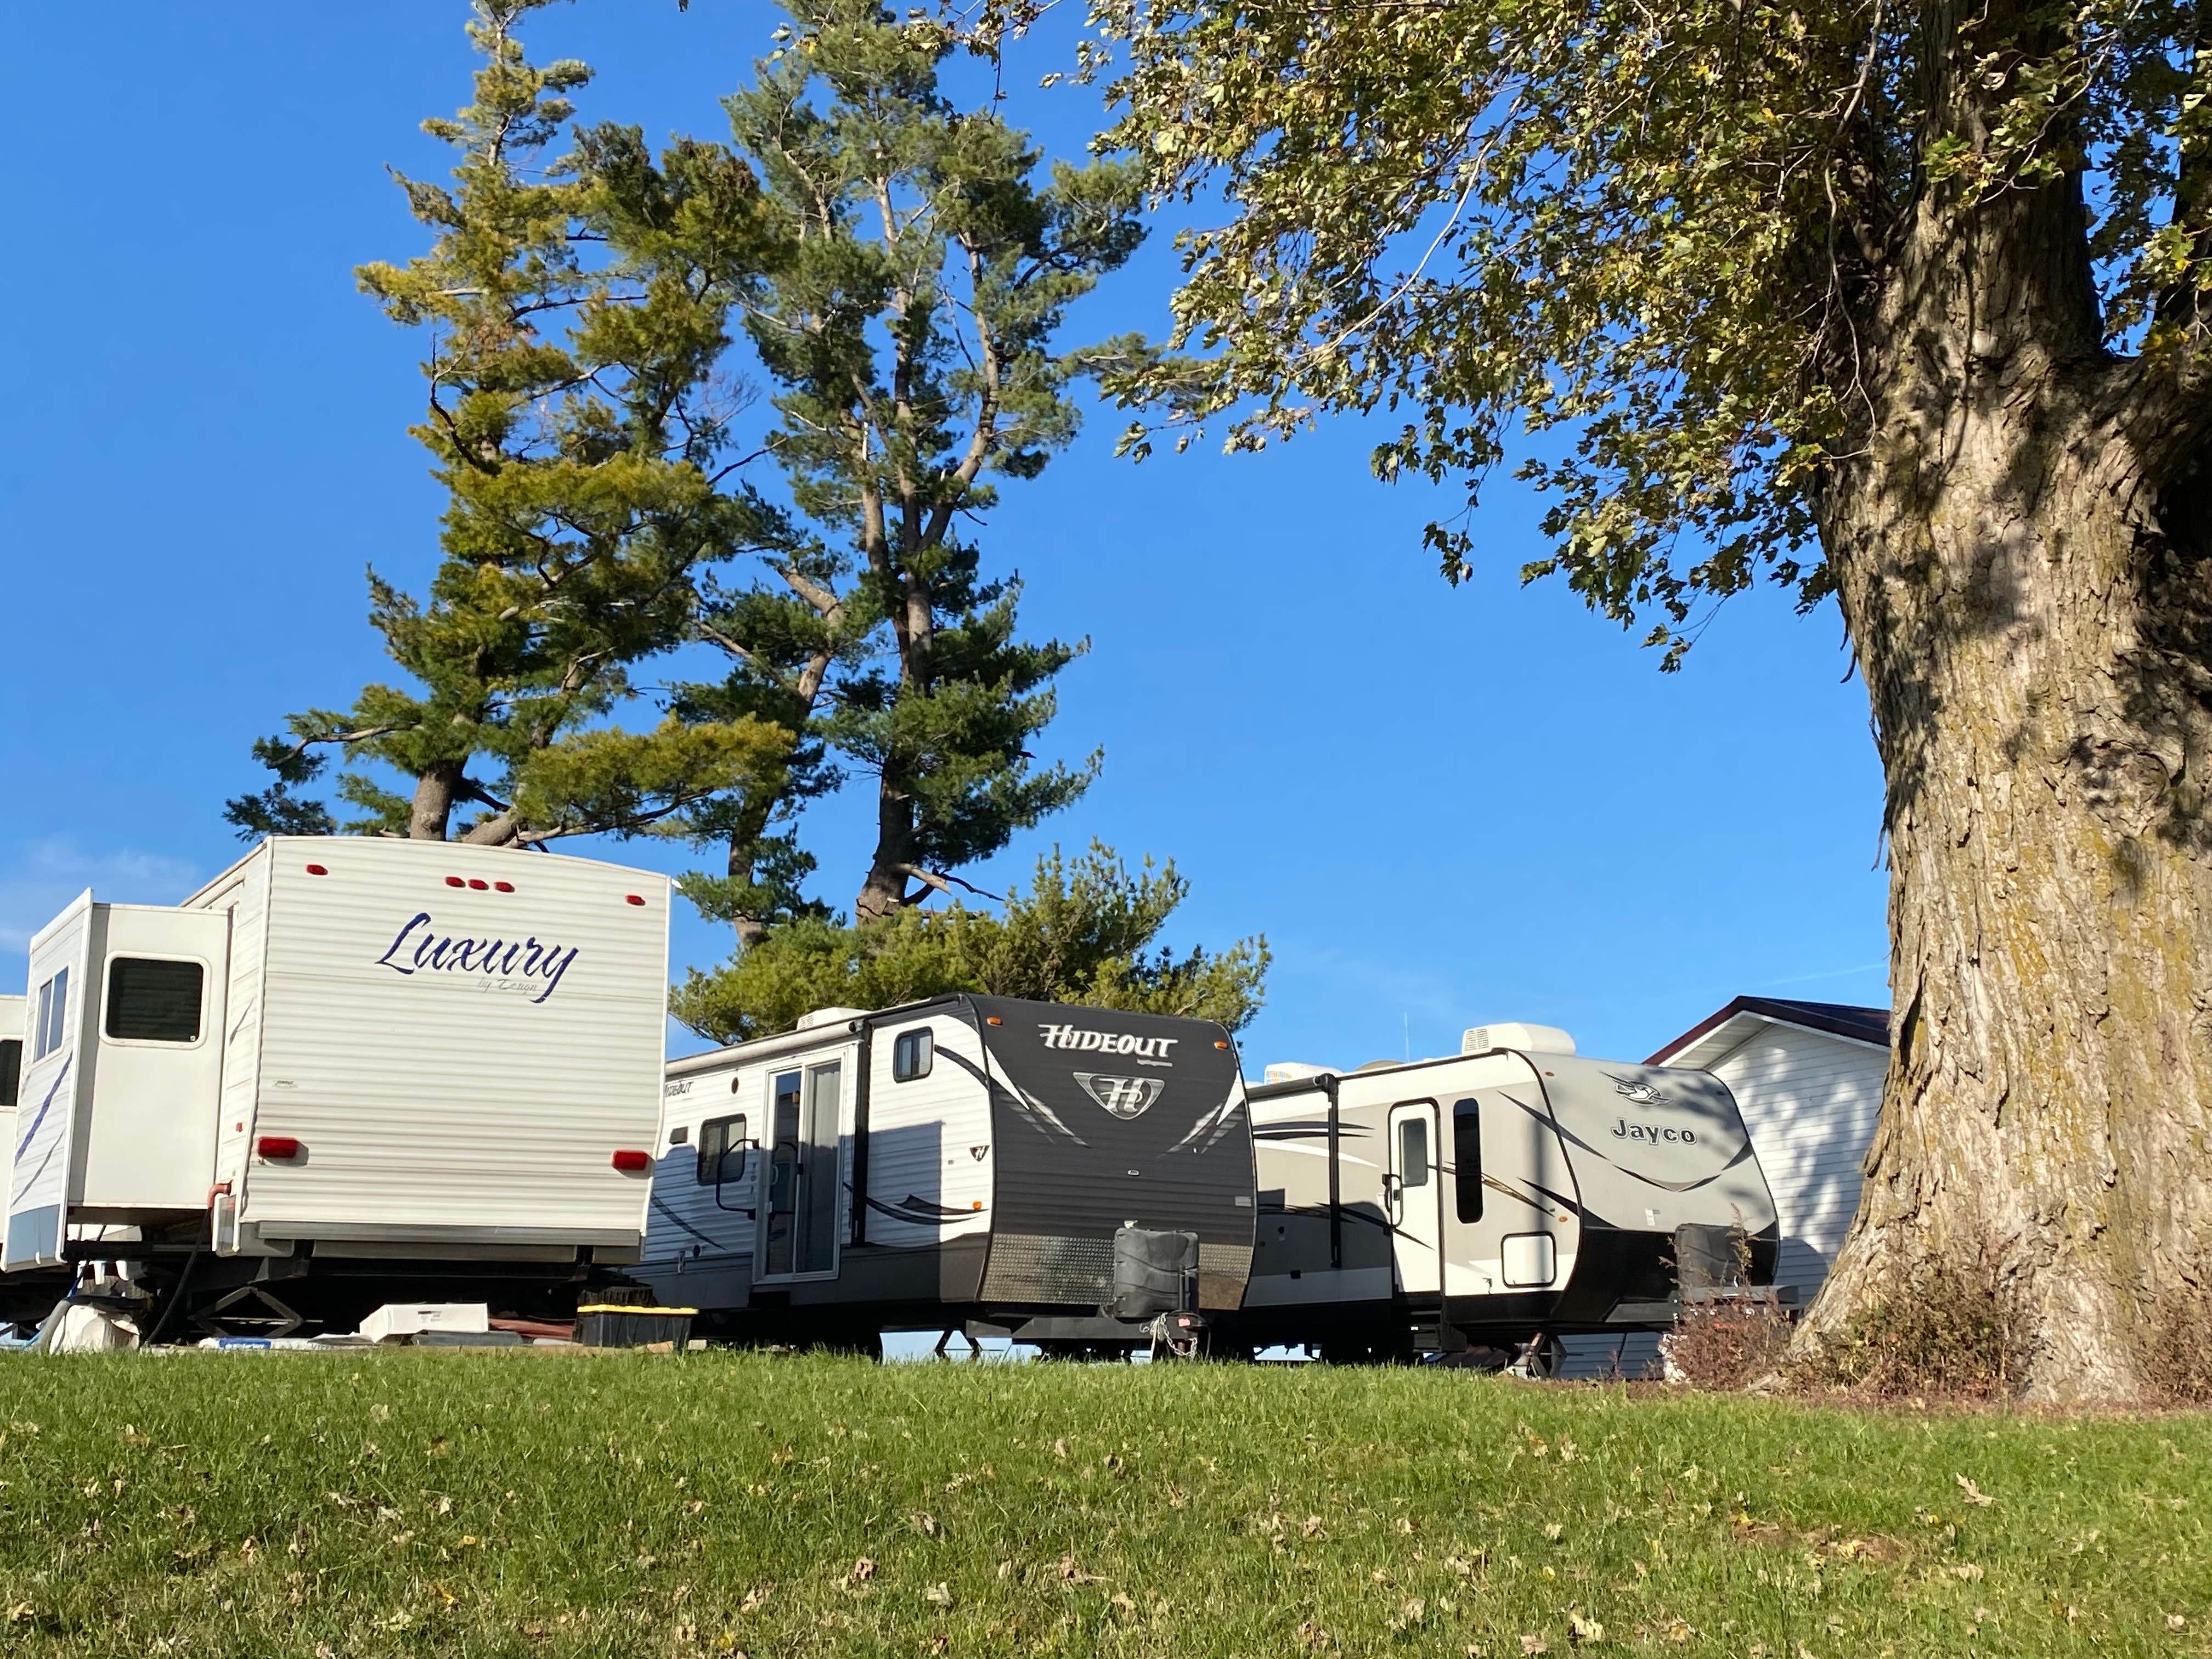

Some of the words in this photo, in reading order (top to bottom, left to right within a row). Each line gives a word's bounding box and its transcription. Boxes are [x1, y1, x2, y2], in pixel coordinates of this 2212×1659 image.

[374, 912, 579, 1003] Luxury
[1037, 1024, 1178, 1058] HIDEOUT
[1611, 1117, 1697, 1146] Jayco
